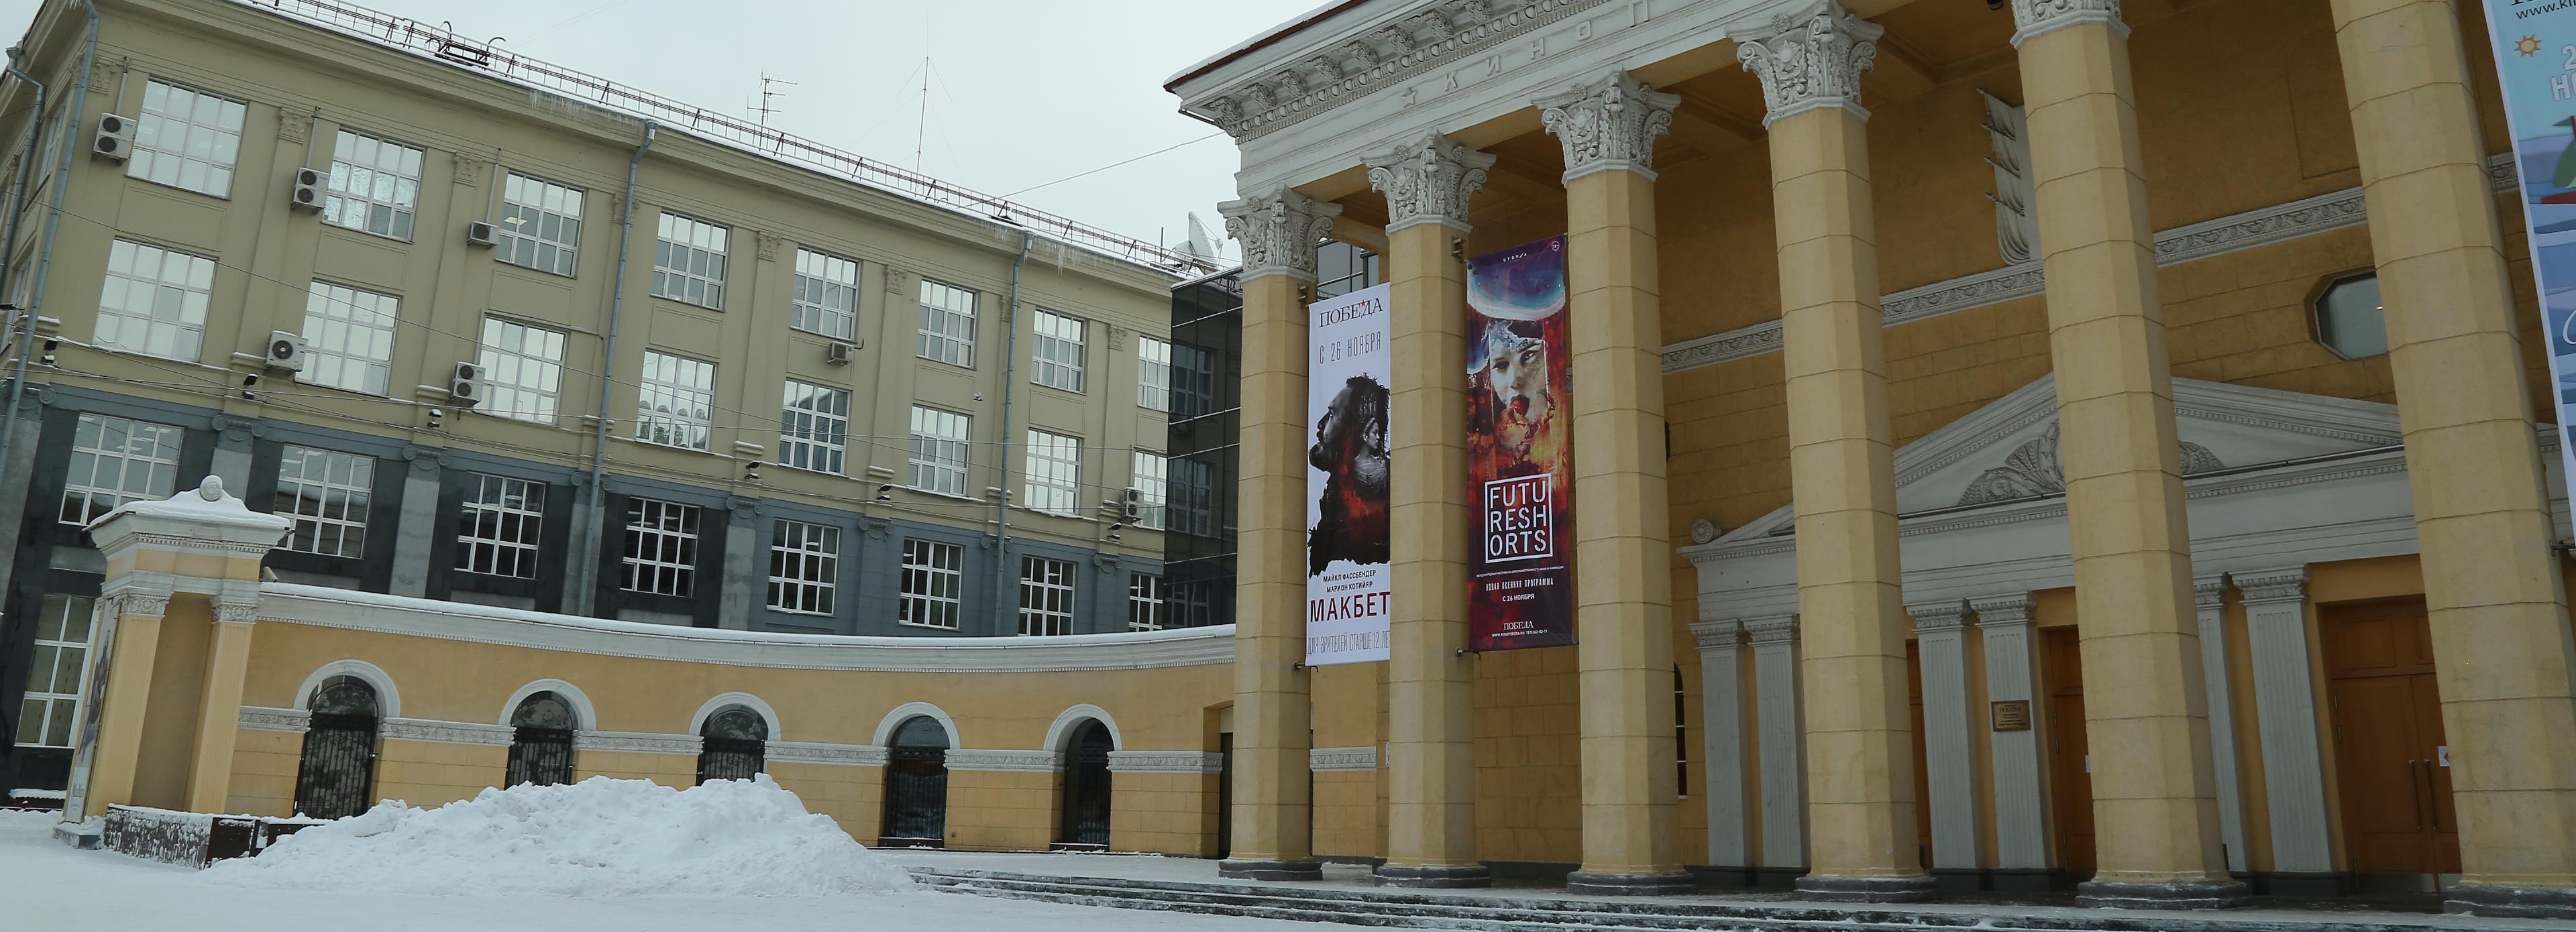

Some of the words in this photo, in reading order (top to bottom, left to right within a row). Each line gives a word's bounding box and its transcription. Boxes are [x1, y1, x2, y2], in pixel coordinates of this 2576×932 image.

[2551, 72, 2576, 101] Н
[1319, 298, 1383, 328] ПОБЕДА
[1320, 345, 1324, 364] С
[1331, 341, 1341, 361] 26
[1348, 331, 1381, 357] НОЯБРЯ
[1490, 481, 1546, 508] FUTU
[1490, 505, 1547, 532] RESH
[1490, 529, 1546, 557] ORTS
[1323, 574, 1342, 583] МАЙКЛ
[1342, 570, 1376, 580] ФАССБЕНДЕР
[1326, 585, 1348, 593] МАРИОН
[1349, 581, 1373, 590] КОТИЙЯР
[1486, 582, 1499, 591] НОВАЯ
[1502, 580, 1521, 589] ОСЕННЯЯ
[1524, 578, 1554, 587] ПРОГРАММА
[1310, 591, 1390, 622] МАКБЕТ
[1503, 621, 1534, 630] ПОБЕДА
[1307, 637, 1319, 655] ДЛЯ
[1320, 632, 1348, 653] ЗРИТЕЛЕЙ
[1350, 632, 1371, 651] СТАРШЕ
[1374, 632, 1379, 649] 12
